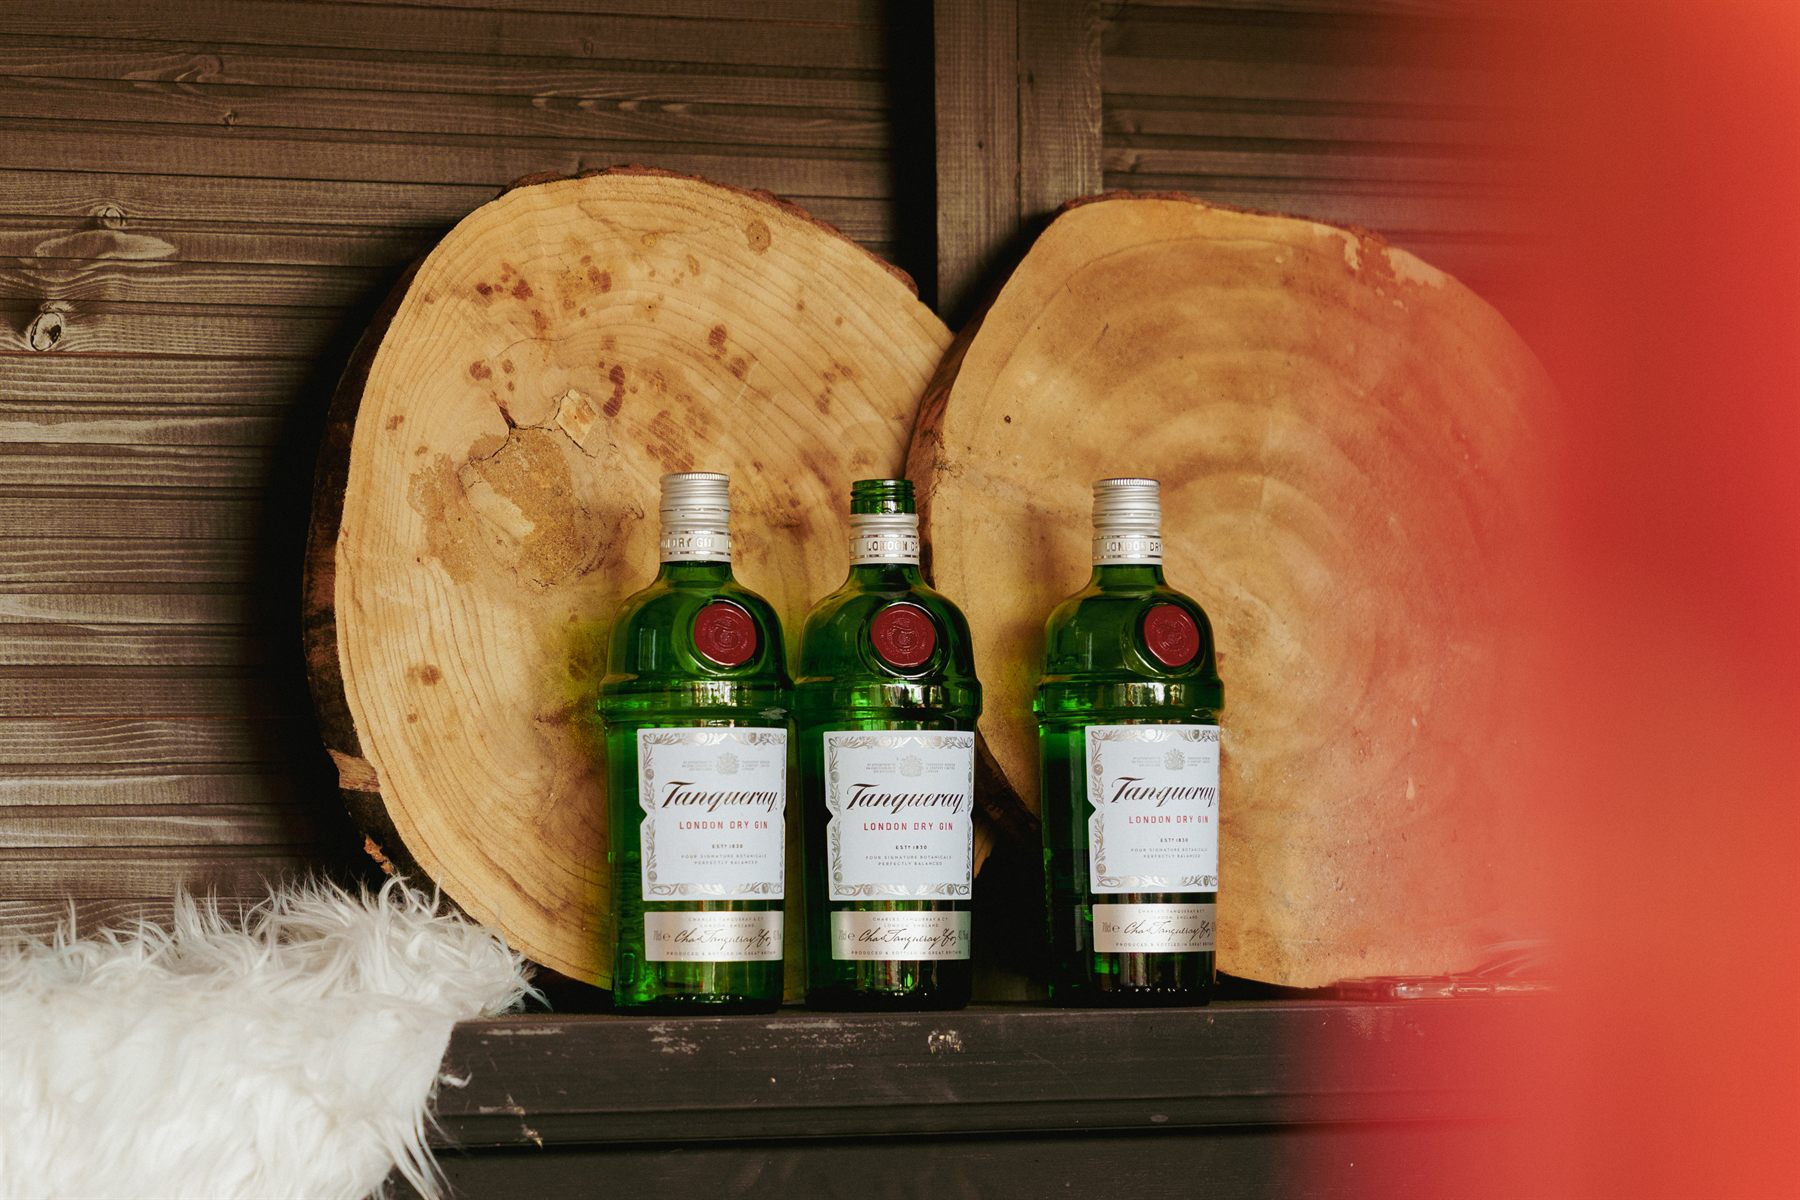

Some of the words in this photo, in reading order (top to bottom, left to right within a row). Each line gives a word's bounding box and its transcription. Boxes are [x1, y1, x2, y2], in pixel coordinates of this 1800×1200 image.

[661, 781, 778, 813] Tanqueray
[846, 783, 964, 815] Tanqueray
[1110, 776, 1216, 808] Tanqueray
[679, 820, 724, 830] LONDON
[729, 820, 750, 830] DRY
[754, 820, 769, 829] GIN
[863, 822, 908, 831] LONDON
[913, 822, 934, 831] DRY
[939, 822, 954, 831] GIN
[1128, 815, 1171, 824] LONDON
[1176, 815, 1194, 824] DRY
[1197, 815, 1209, 824] GIN
